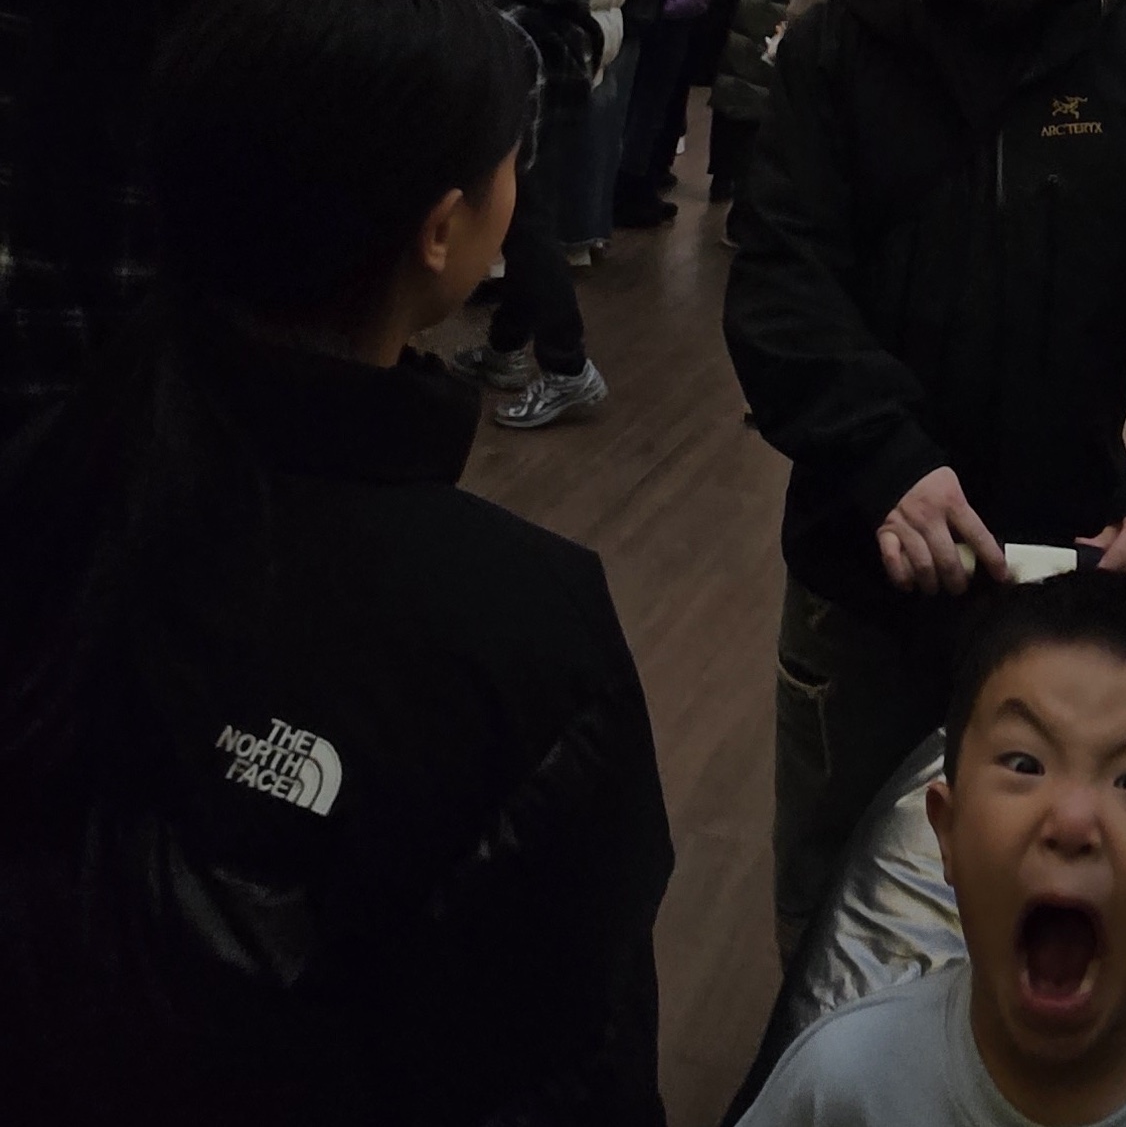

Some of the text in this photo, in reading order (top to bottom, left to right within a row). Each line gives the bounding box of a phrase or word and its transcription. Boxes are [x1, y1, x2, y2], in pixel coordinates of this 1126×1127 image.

[215, 724, 305, 777] NORTH
[267, 717, 317, 756] THE
[225, 758, 298, 799] FACE
